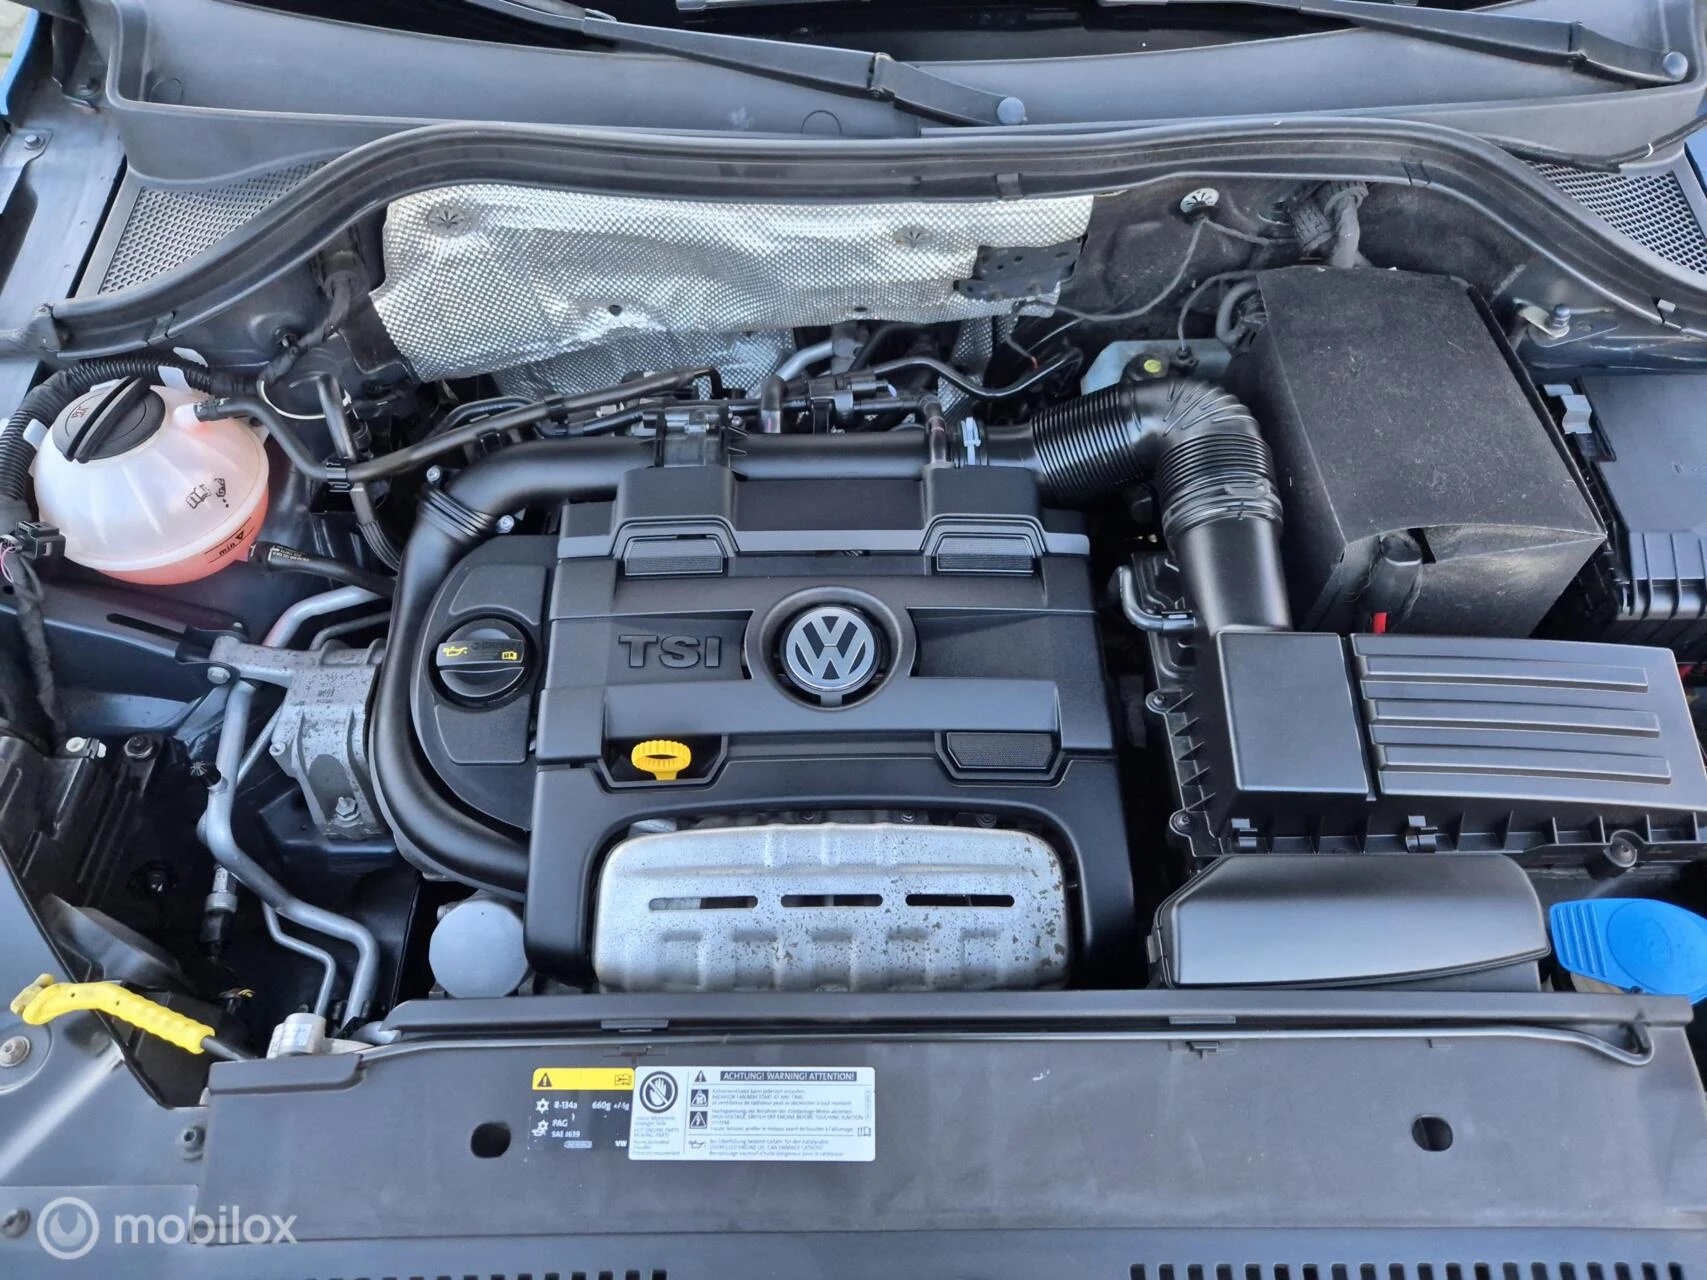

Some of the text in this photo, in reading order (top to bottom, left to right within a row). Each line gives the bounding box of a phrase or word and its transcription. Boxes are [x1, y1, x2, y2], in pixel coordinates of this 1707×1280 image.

[219, 543, 235, 556] min
[619, 634, 722, 669] TSI
[723, 1071, 855, 1081] ACHTUNG! WARNING! ATTENTION!
[551, 1118, 568, 1128] PAG
[551, 1130, 564, 1138] SAE
[614, 1140, 628, 1148] VW
